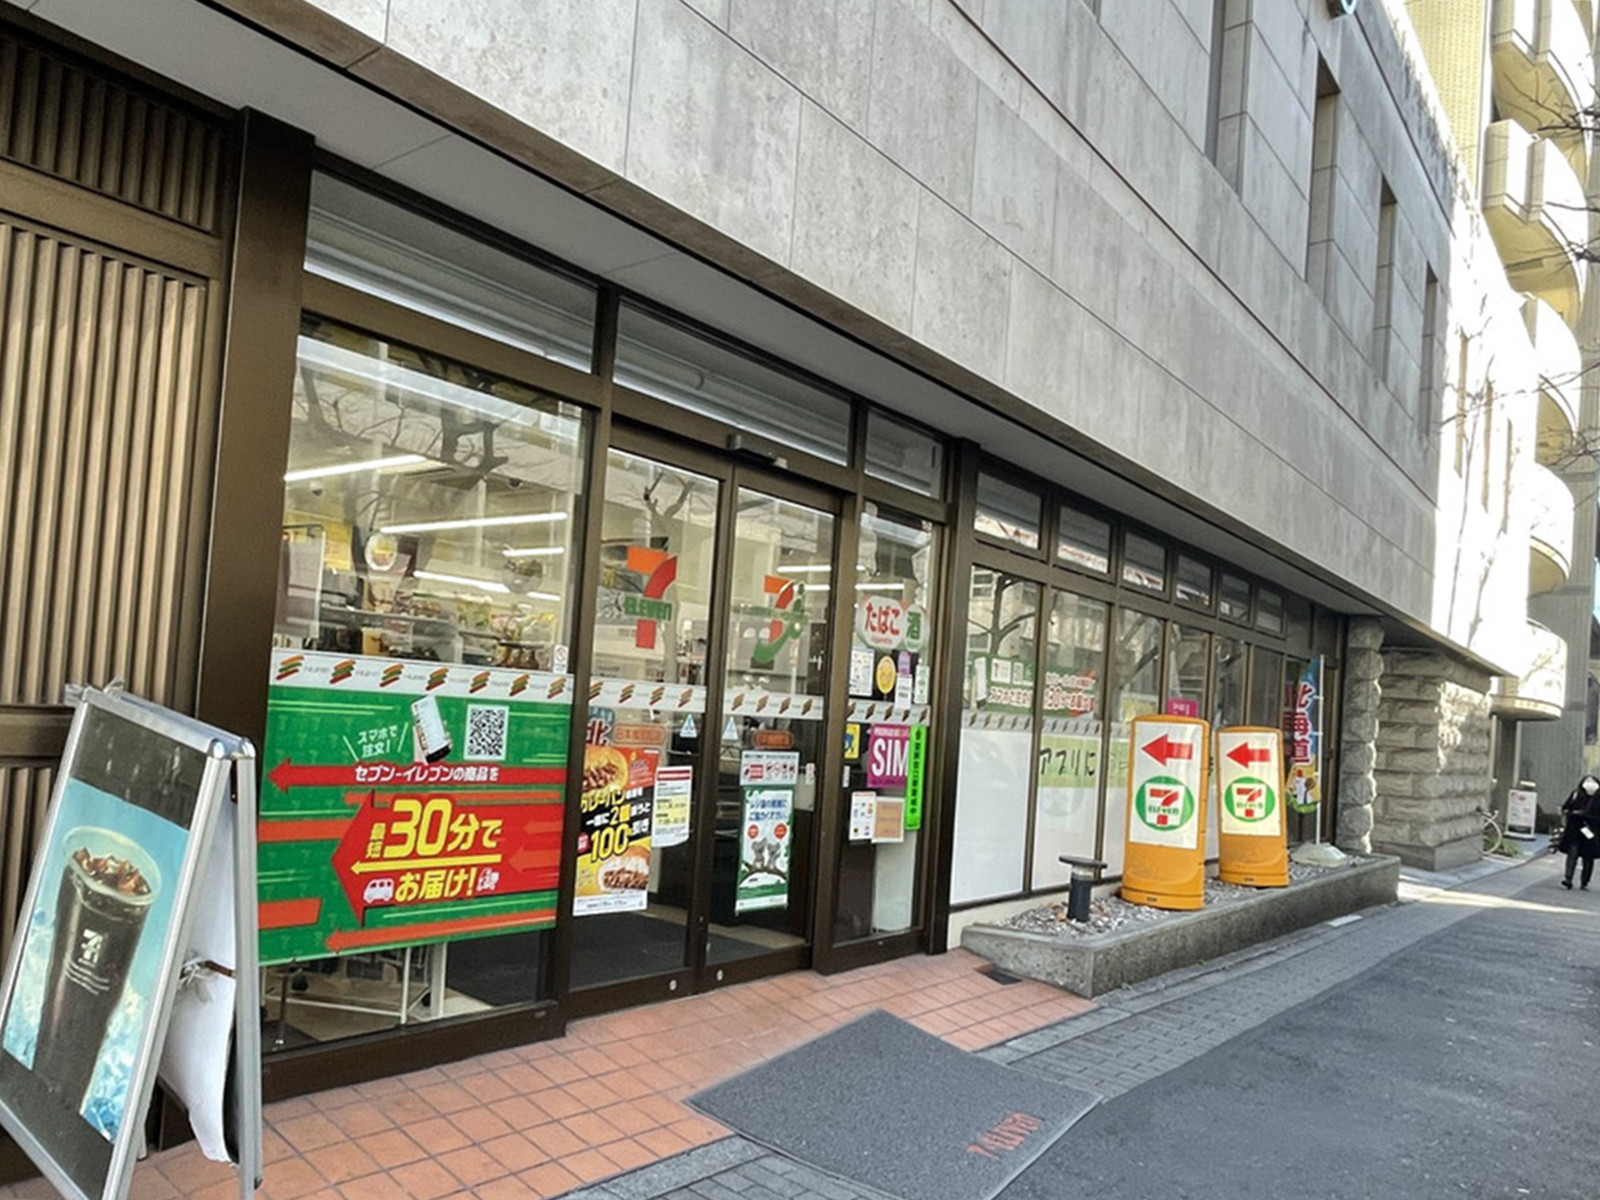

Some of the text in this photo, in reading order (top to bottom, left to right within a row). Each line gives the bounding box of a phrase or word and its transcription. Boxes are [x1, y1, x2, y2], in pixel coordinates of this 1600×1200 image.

[865, 602, 900, 636] たばこ
[906, 611, 922, 639] 酒
[357, 725, 398, 744] スマホで
[362, 740, 391, 758] 注文!
[871, 738, 910, 777] SIM
[355, 765, 499, 782] セブン-イレブンの商品を
[383, 798, 502, 859] 30分で
[395, 867, 477, 902] お届け!
